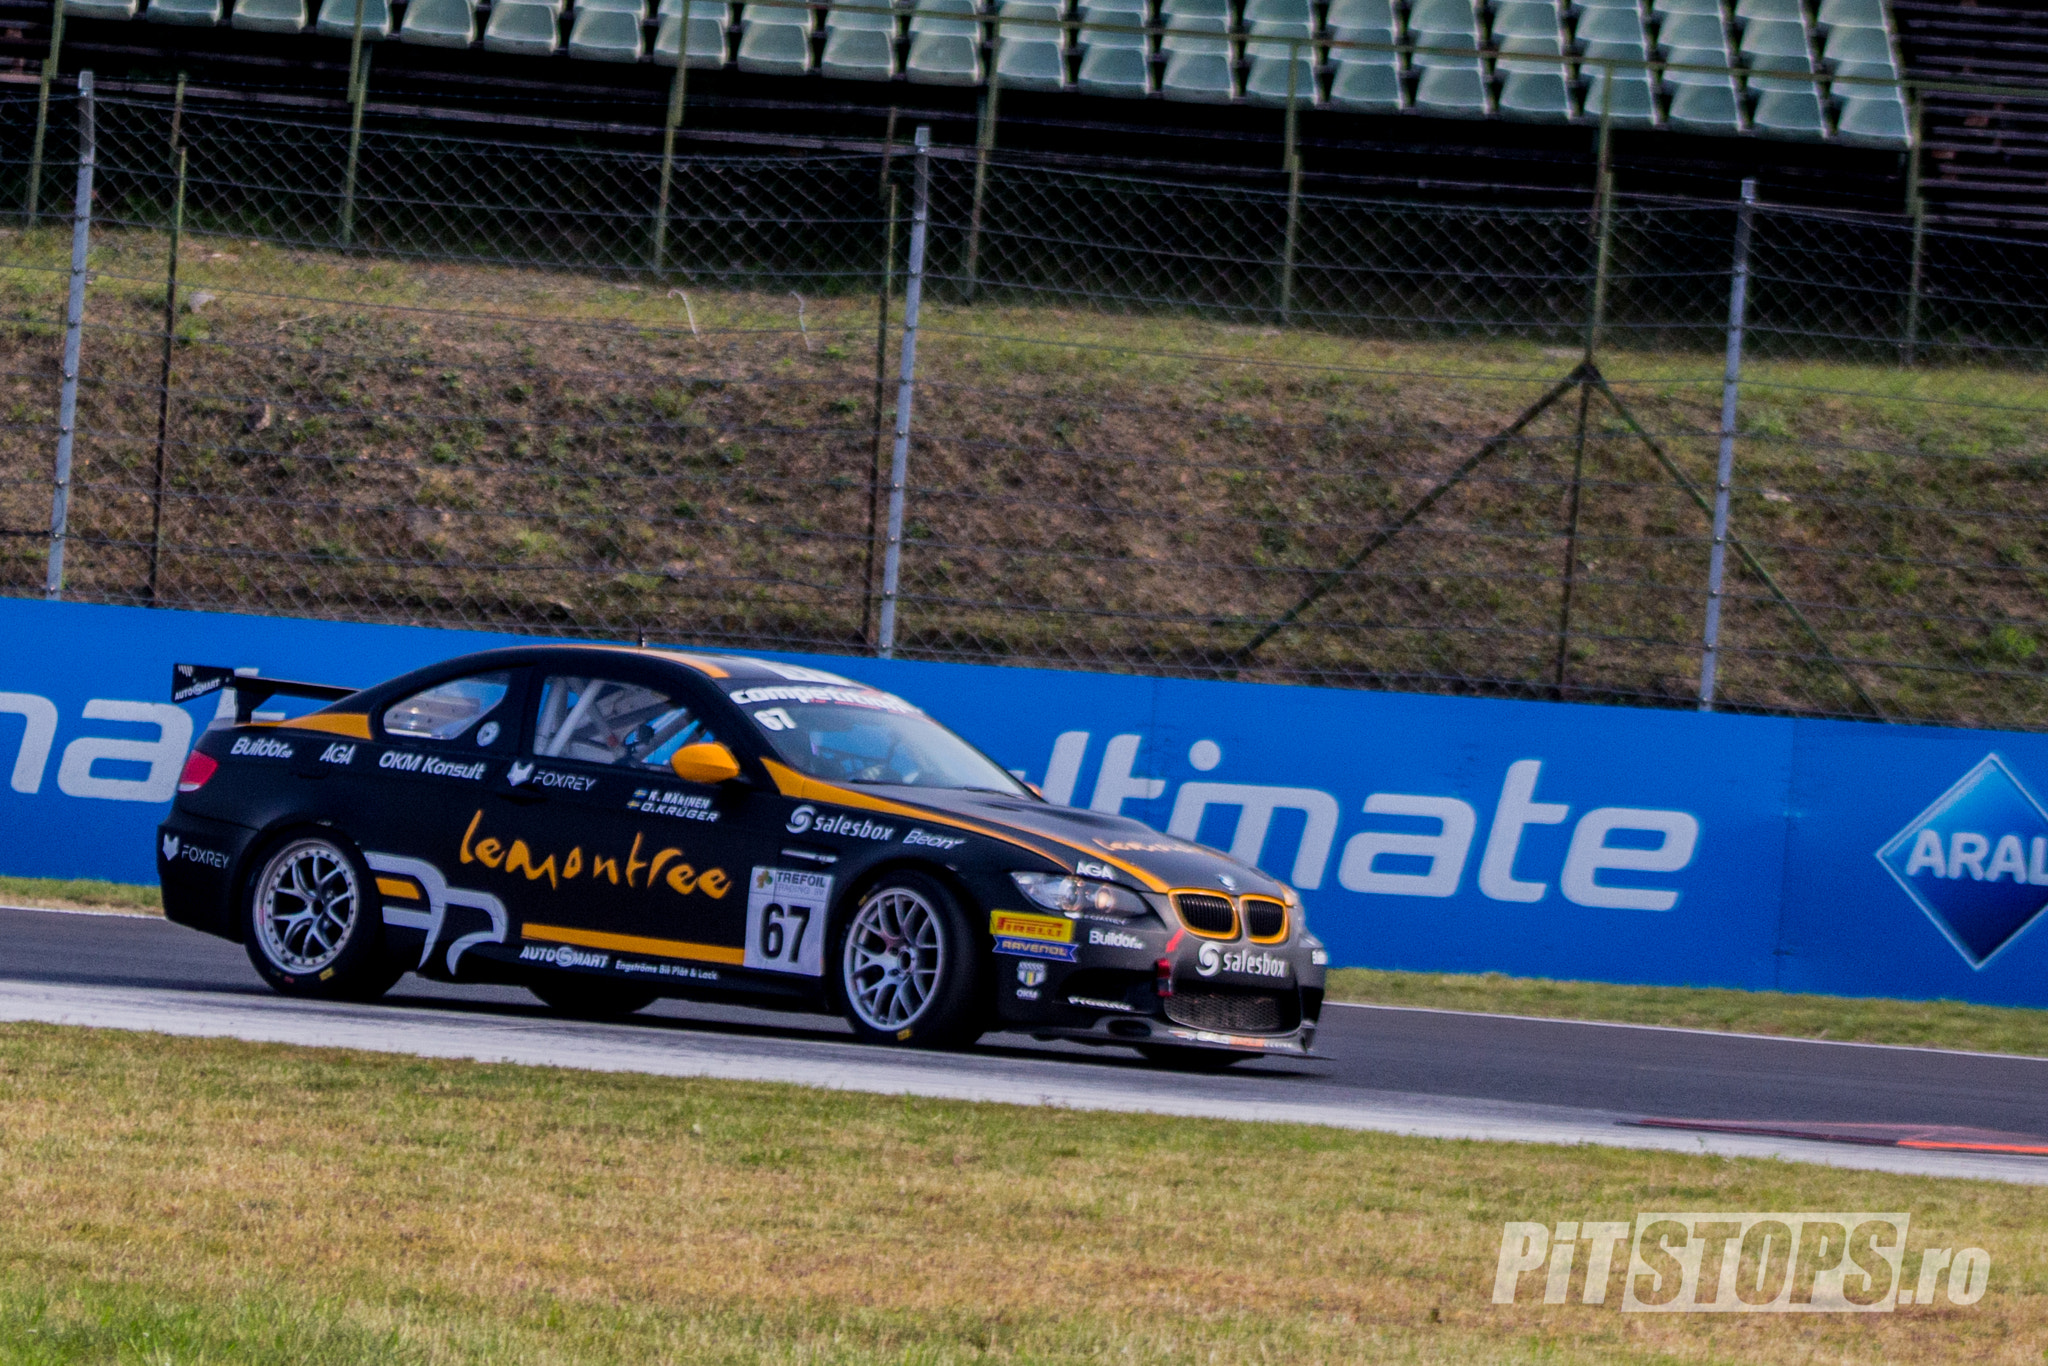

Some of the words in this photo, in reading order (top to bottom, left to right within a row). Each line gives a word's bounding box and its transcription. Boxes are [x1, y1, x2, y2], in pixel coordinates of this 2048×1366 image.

[754, 707, 797, 731] 67
[319, 743, 356, 765] AGA
[379, 750, 420, 772] OKM
[421, 756, 488, 781] Konsult
[532, 771, 596, 792] FOXREY
[813, 815, 893, 842] salesbox
[182, 845, 230, 869] FOXREY
[459, 809, 733, 899] lemontree
[1906, 829, 2048, 886] ARAL
[776, 871, 825, 888] TREFOIL
[1076, 861, 1115, 880] AGA
[761, 903, 811, 963] 67
[997, 916, 1064, 937] PIRELLI
[1001, 940, 1069, 956] RAVENOL
[1222, 949, 1288, 978] salesbox
[1016, 987, 1039, 1000] OKM
